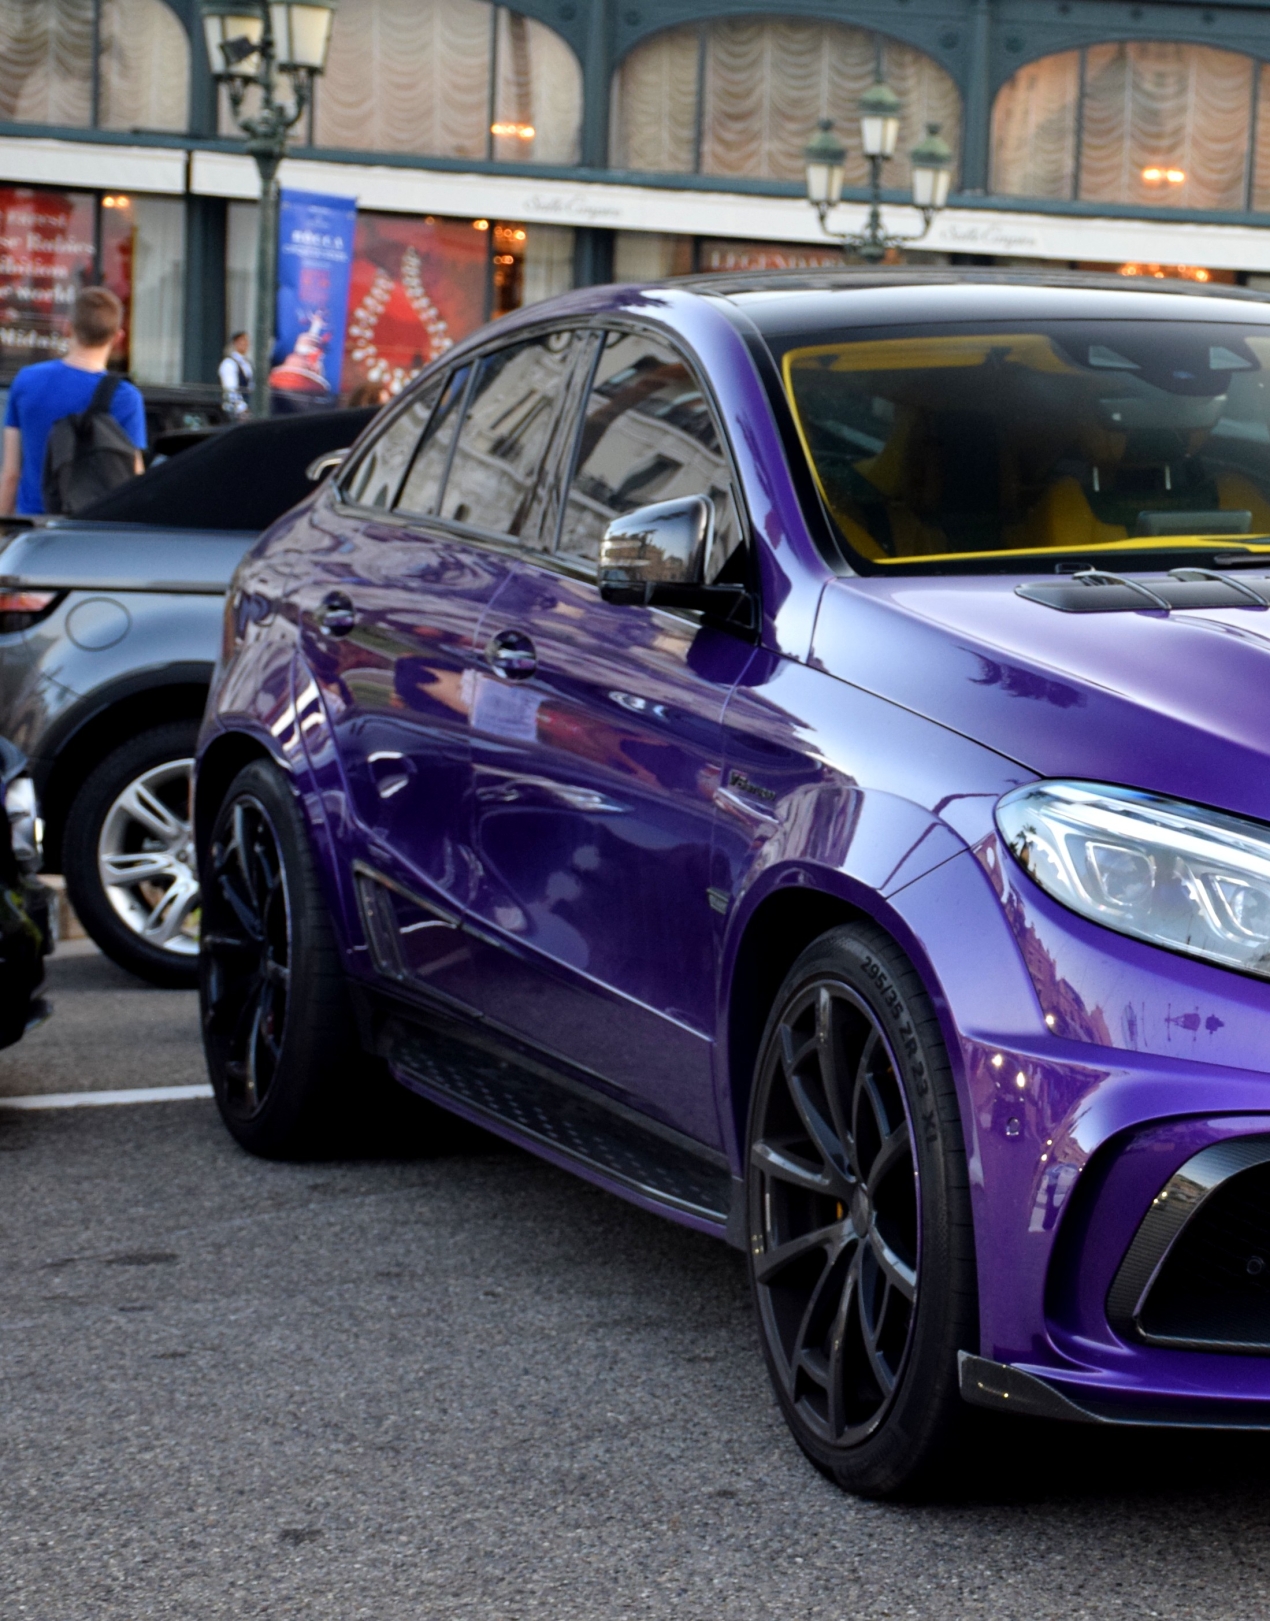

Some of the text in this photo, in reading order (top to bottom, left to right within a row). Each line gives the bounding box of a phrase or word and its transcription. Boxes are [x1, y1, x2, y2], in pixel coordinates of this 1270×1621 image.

[0, 255, 69, 279] ibition
[16, 284, 76, 304] world
[0, 328, 70, 356] Midnig
[860, 956, 904, 1019] 295/35
[898, 1021, 918, 1056] ZR
